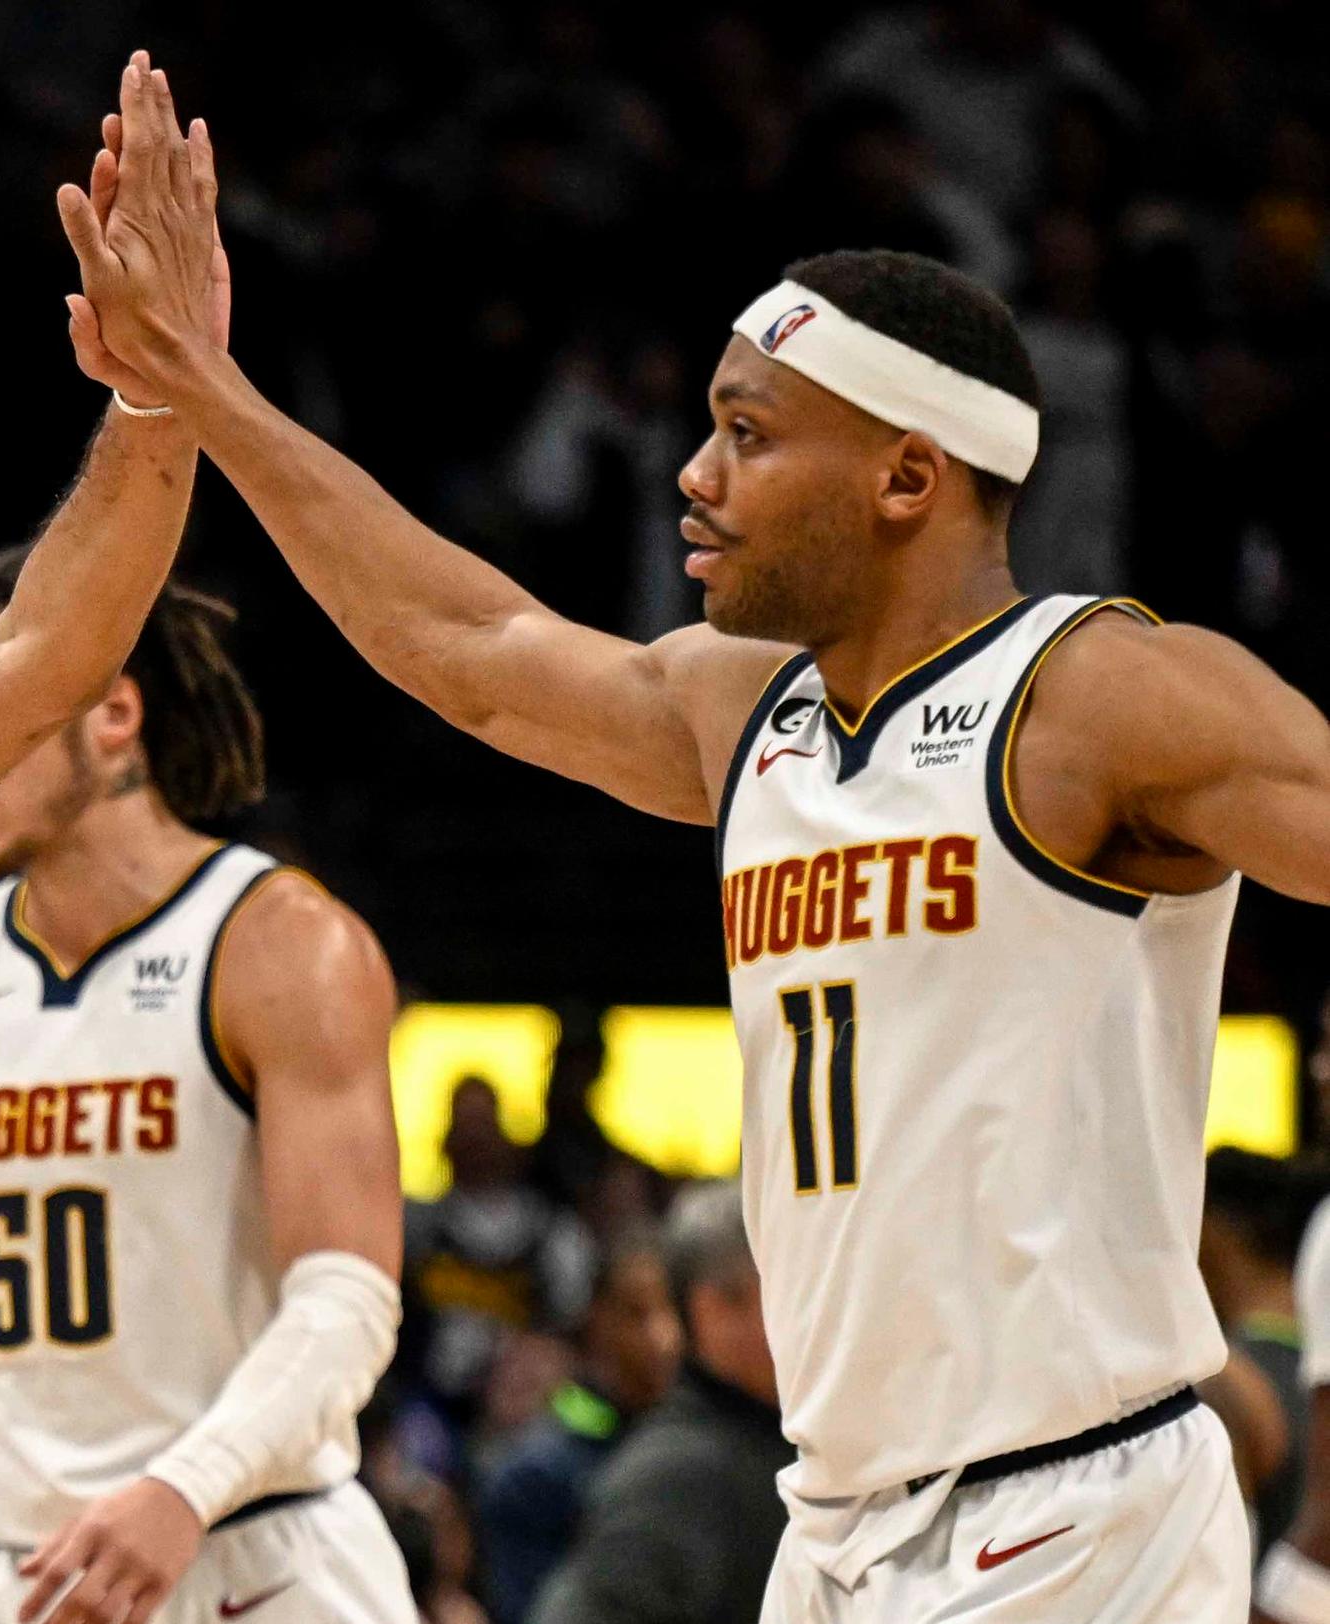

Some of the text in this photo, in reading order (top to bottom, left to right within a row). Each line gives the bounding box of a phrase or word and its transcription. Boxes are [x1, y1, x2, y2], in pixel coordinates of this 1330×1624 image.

[923, 701, 989, 736] WU
[910, 737, 974, 756] Western
[915, 752, 959, 769] Union
[723, 833, 980, 974] NUGGETS
[778, 978, 860, 1196] 11
